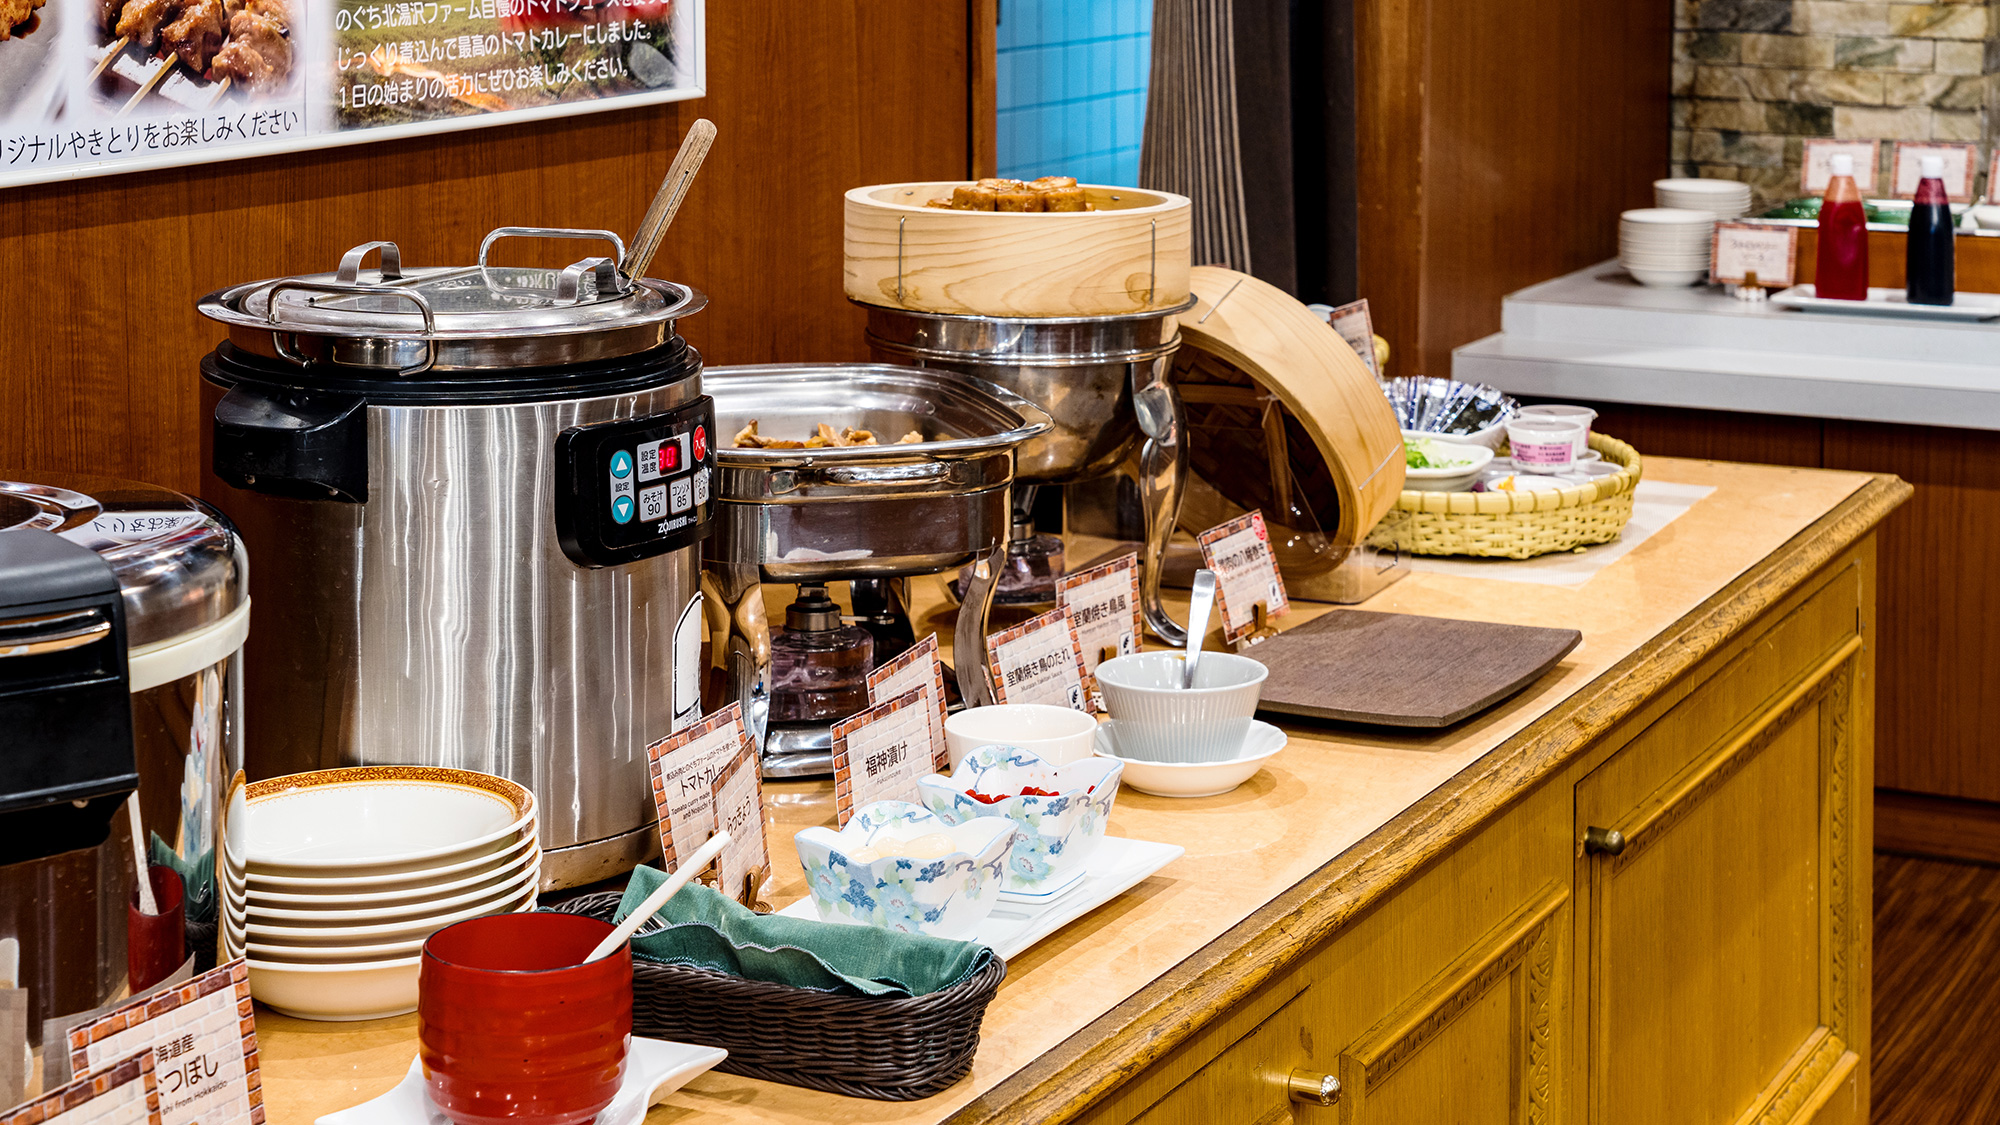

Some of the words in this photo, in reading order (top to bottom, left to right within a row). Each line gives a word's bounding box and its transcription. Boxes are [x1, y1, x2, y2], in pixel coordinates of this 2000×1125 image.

[338, 18, 652, 71] じっくり煮込んで最高のトマトカレーにしました。
[339, 57, 629, 109] 1日の始まりの活力にぜひお楽しみください。
[643, 490, 663, 504] みそ汁
[647, 503, 661, 515] 90
[676, 495, 687, 507] 85
[1006, 648, 1071, 688] 室蘭焼き鳥のたれ
[865, 740, 908, 779] 福神漬け
[175, 1096, 193, 1109] from
[194, 1080, 228, 1100] Hokkaido
